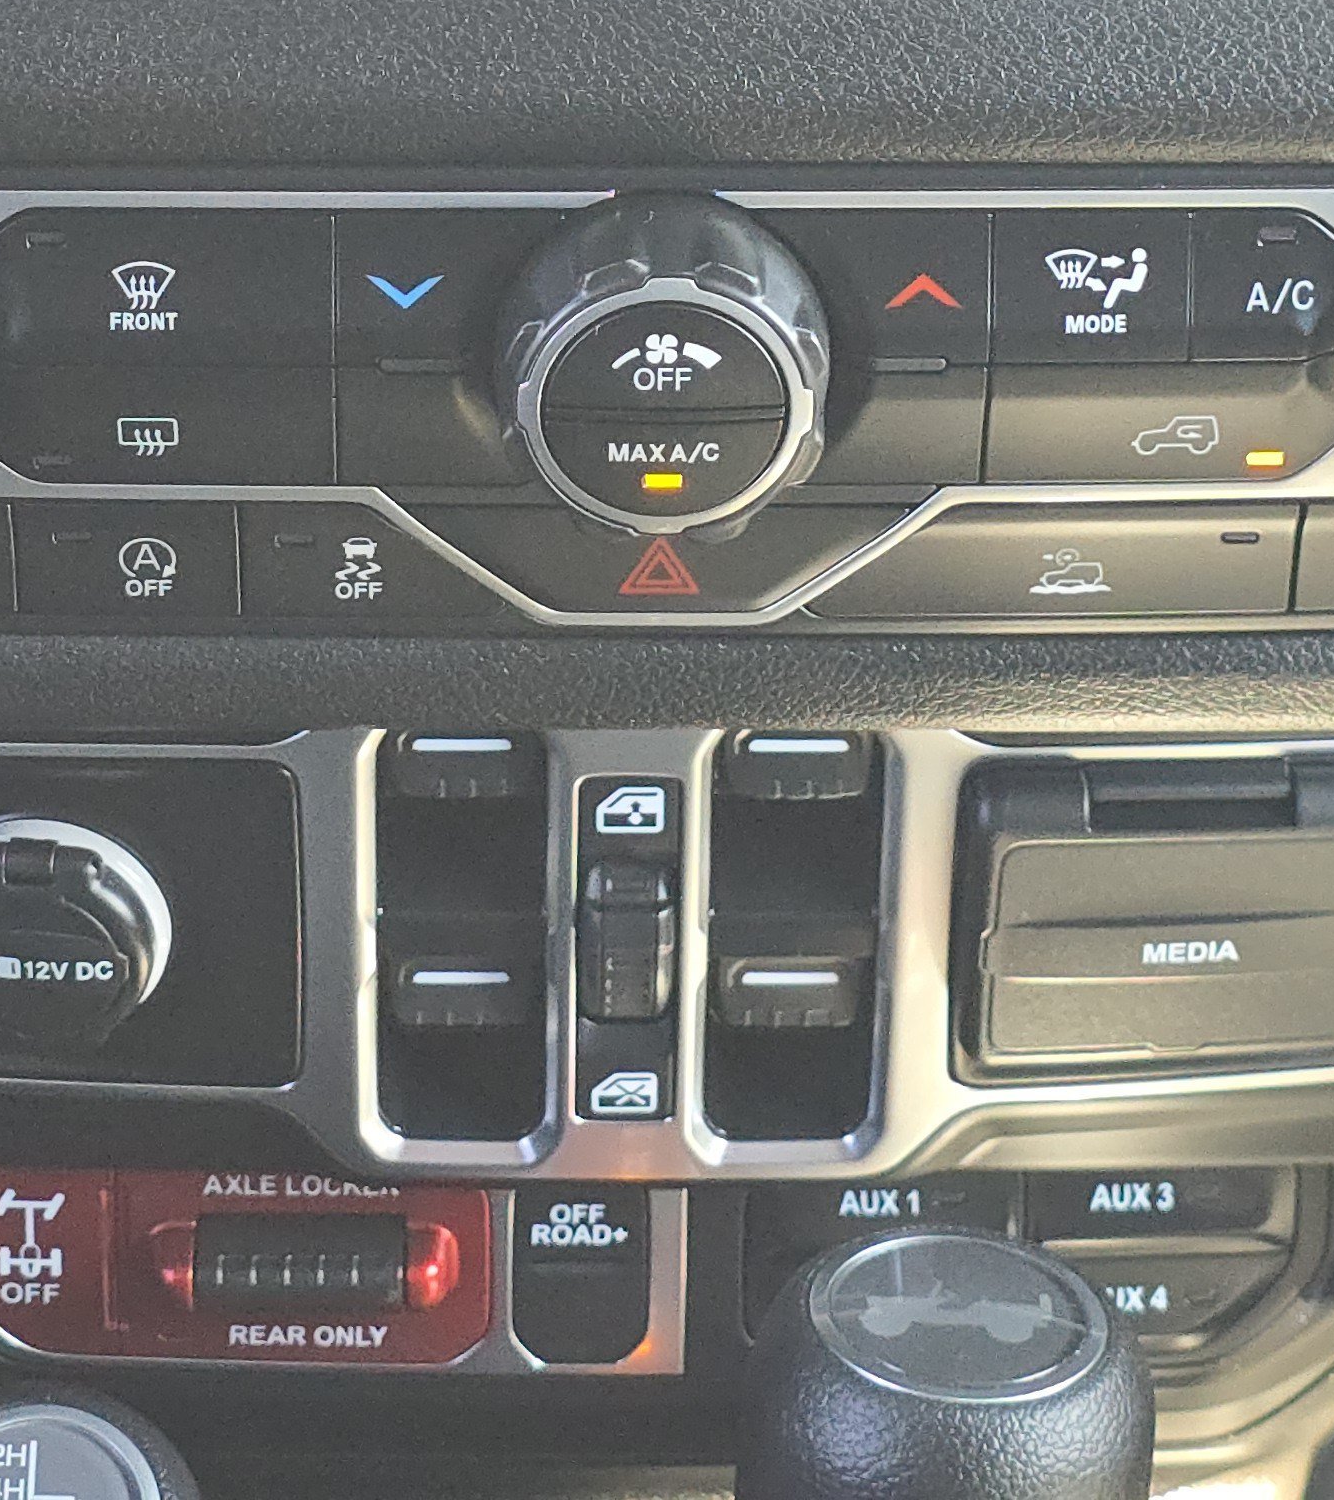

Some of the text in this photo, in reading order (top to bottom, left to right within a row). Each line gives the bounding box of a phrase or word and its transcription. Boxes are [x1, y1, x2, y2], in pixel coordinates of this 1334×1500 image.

[1246, 280, 1316, 314] A/C
[109, 312, 177, 331] FRONT
[1064, 314, 1128, 334] MODE
[633, 367, 693, 392] OFF
[608, 441, 720, 463] MAX A/C
[124, 579, 173, 598] OFF
[334, 580, 382, 600] OFF
[1141, 941, 1240, 966] MEDIA
[24, 961, 113, 980] 12V DC
[203, 1174, 277, 1197] AXLE
[1090, 1183, 1175, 1211] AUX 3
[549, 1203, 605, 1223] OFF
[839, 1190, 921, 1217] AUX 1
[531, 1222, 629, 1247] ROAD+
[0, 1283, 61, 1304] OFF
[1149, 1284, 1168, 1311] 4
[228, 1325, 388, 1348] REAR ONLY
